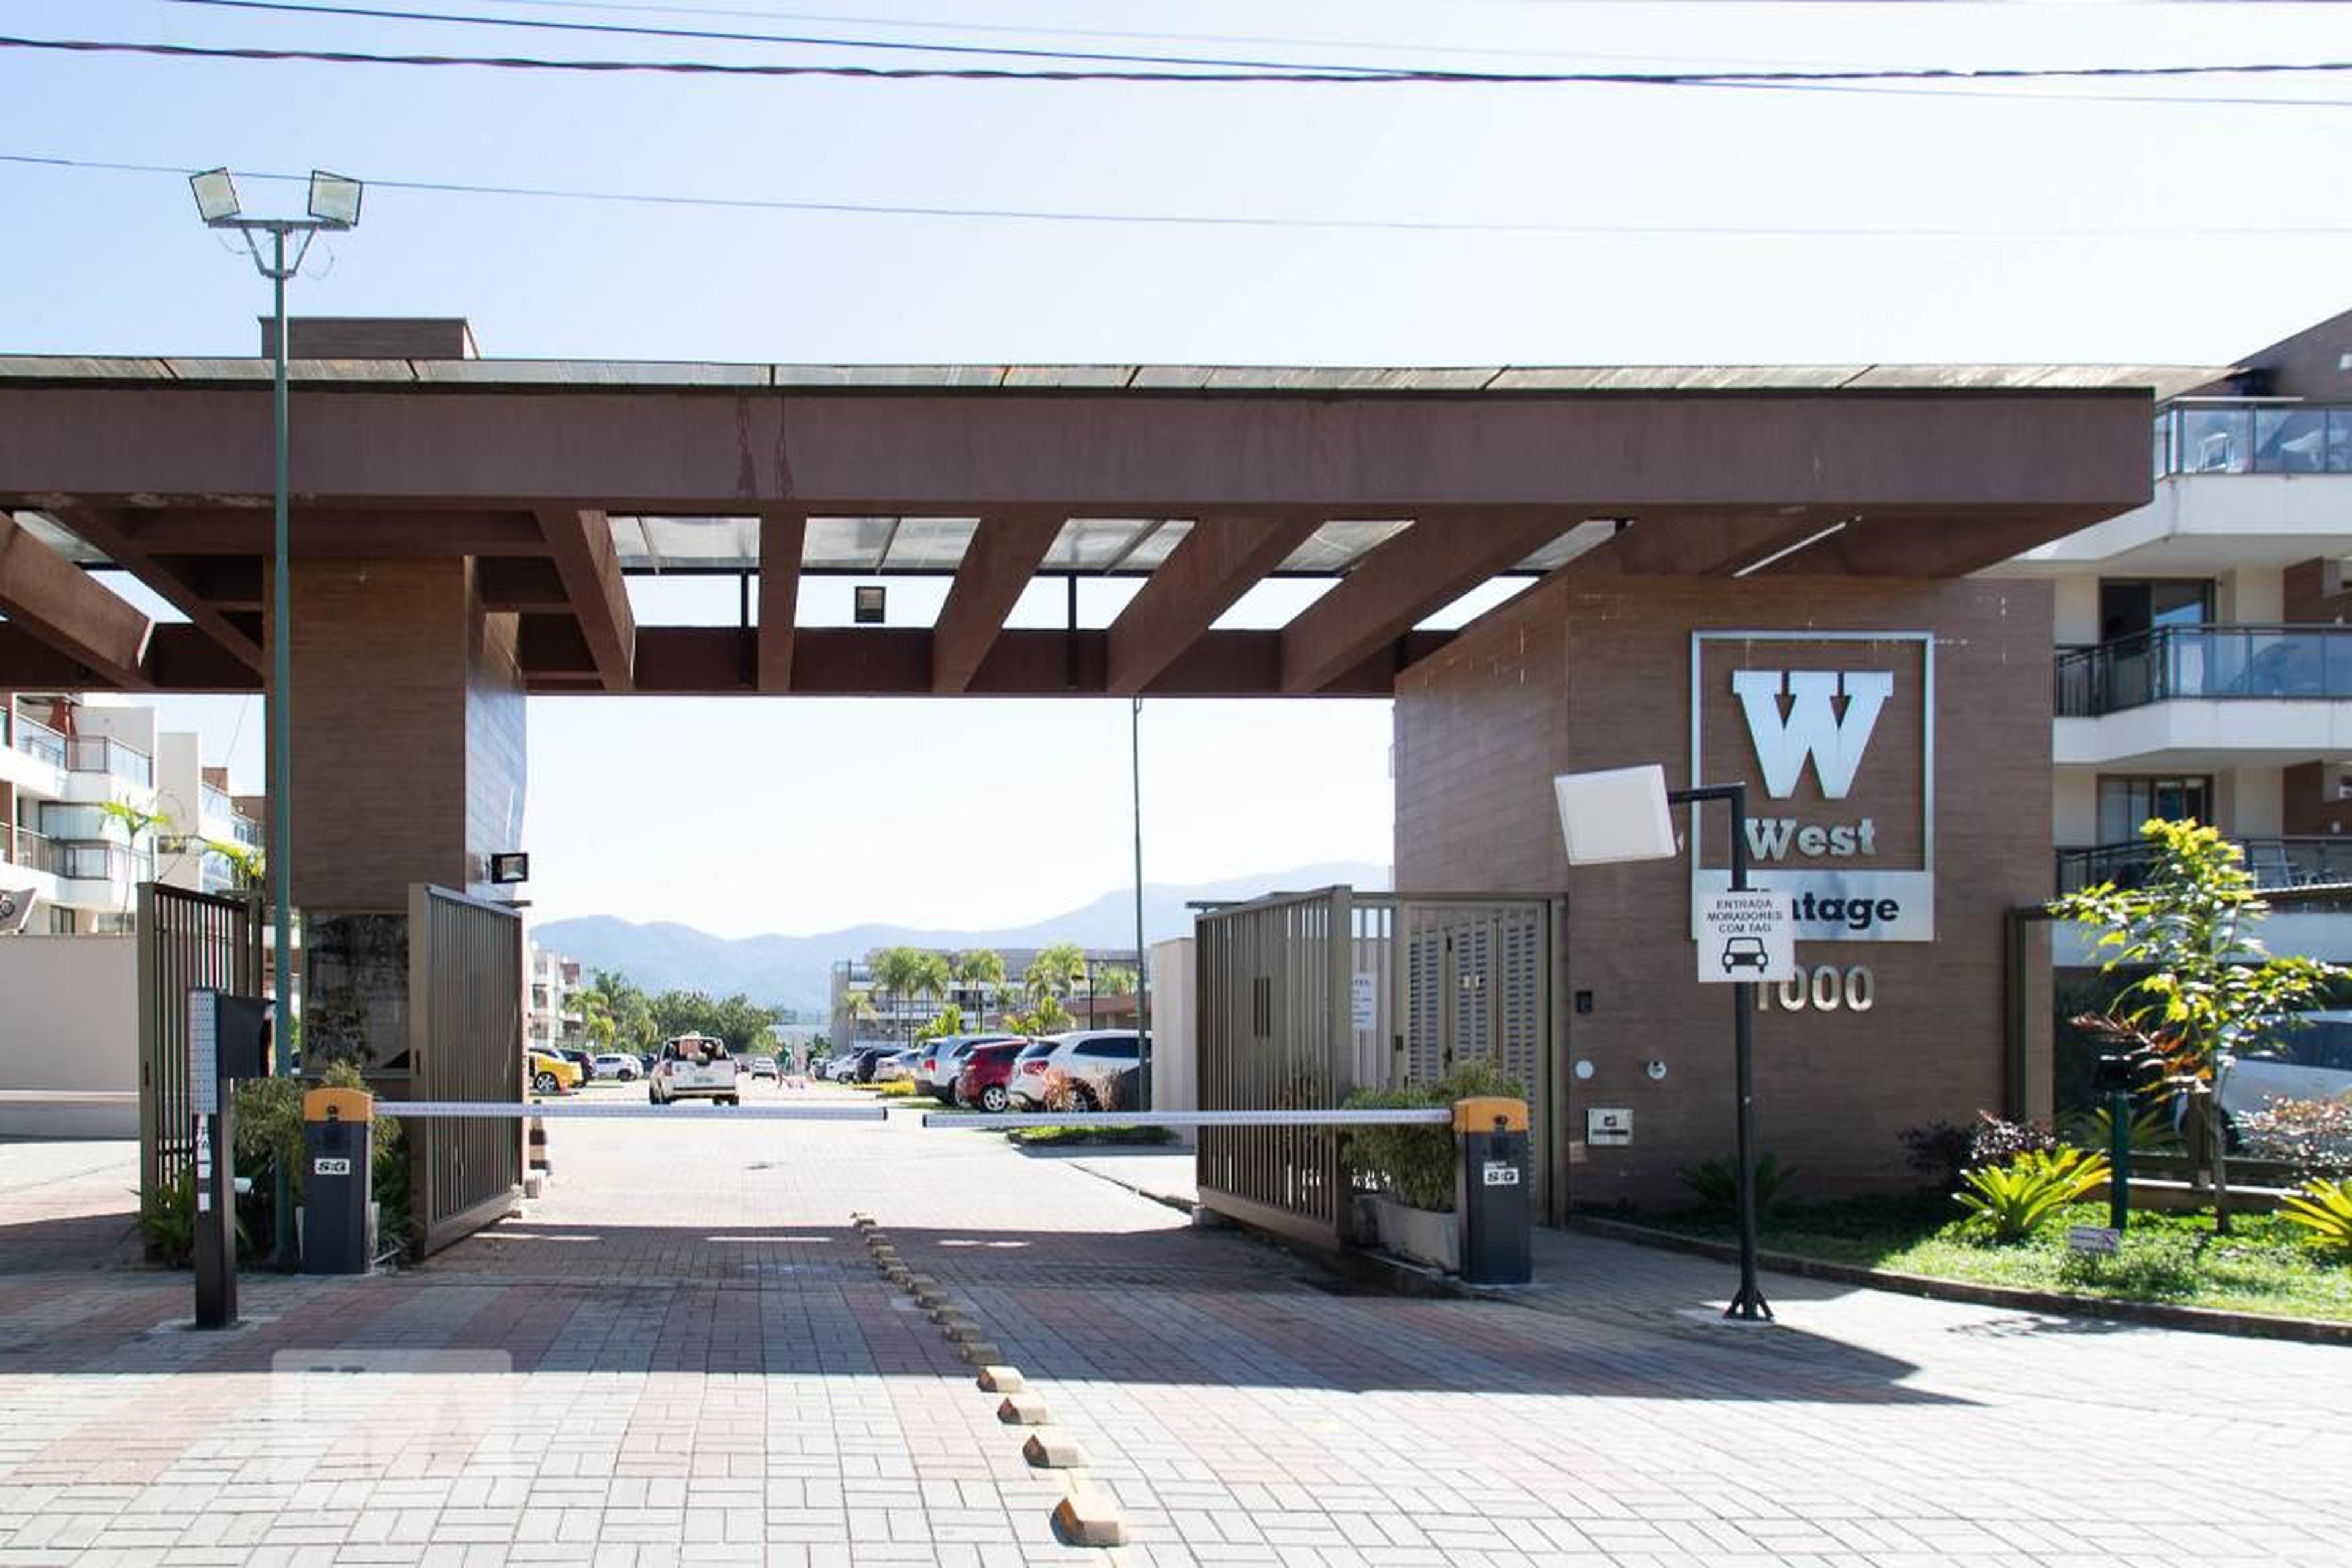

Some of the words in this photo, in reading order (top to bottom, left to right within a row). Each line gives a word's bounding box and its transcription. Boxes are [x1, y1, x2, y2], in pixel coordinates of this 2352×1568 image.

[1733, 670, 1894, 799] W
[1746, 818, 1877, 860] West
[1706, 911, 1783, 921] MORADORES
[1716, 899, 1773, 910] ENTRADA
[1718, 923, 1744, 933] COM
[1749, 922, 1772, 932] TAG
[1757, 965, 1874, 1011] 1000
